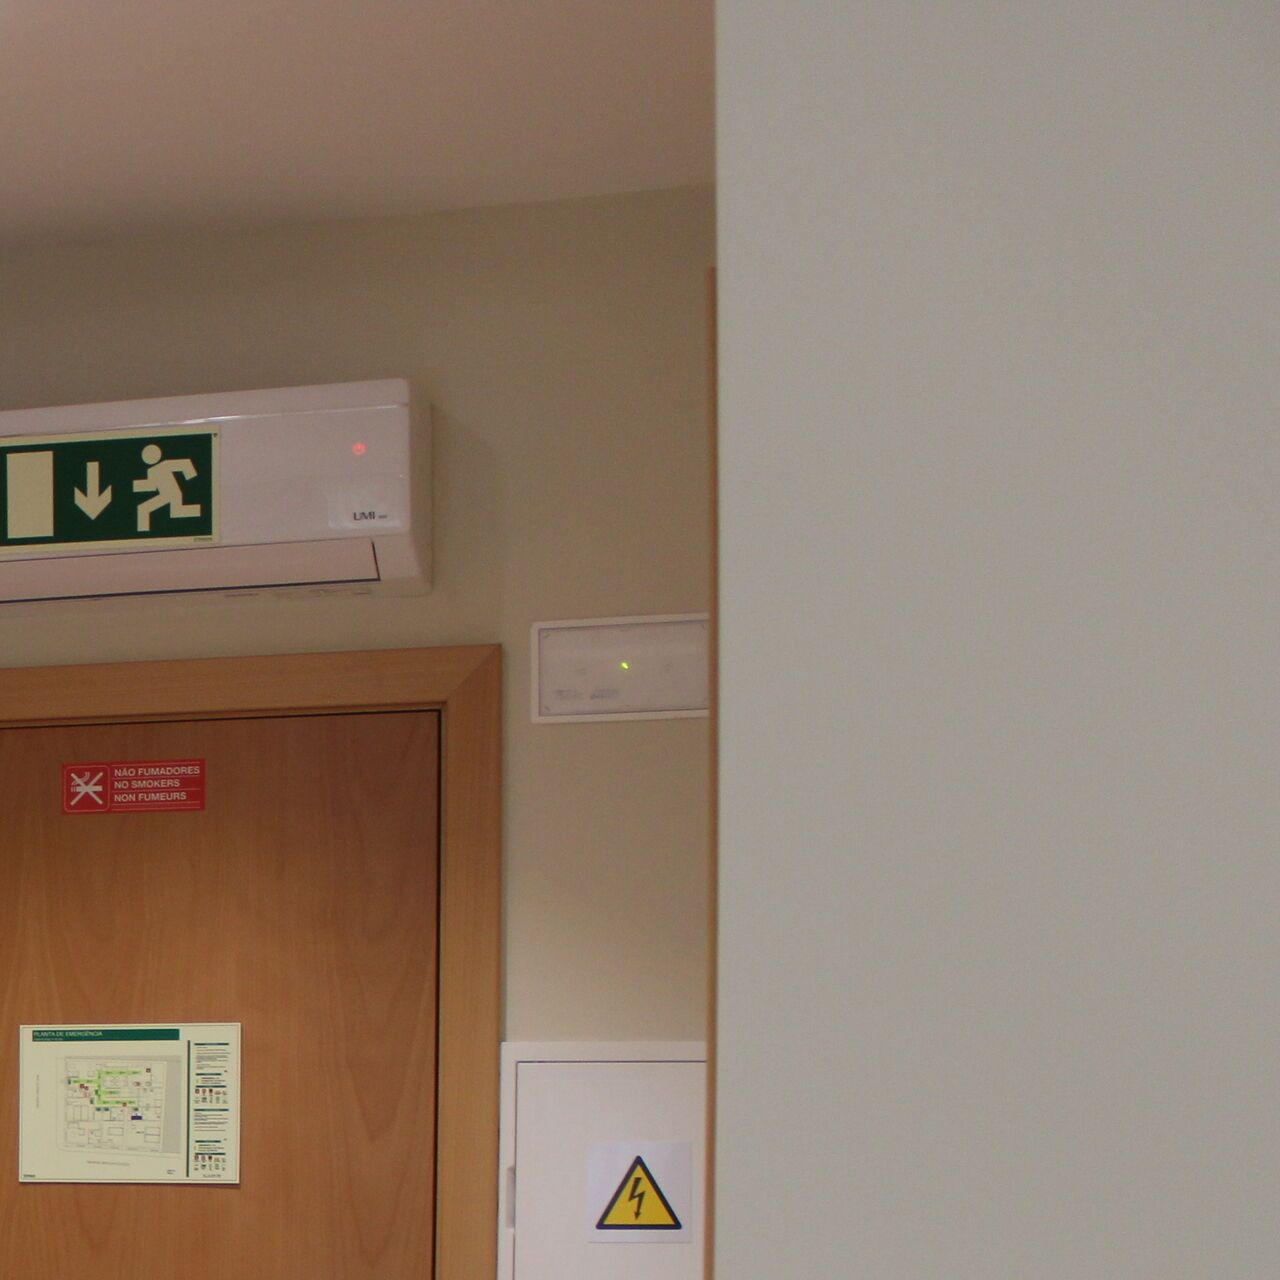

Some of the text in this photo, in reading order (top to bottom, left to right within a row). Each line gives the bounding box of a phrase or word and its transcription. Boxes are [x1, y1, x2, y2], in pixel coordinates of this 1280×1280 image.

[138, 766, 200, 776] FUMADORES
[114, 779, 180, 789] NO SMOKERS
[114, 791, 187, 802] NON FUMEURS
